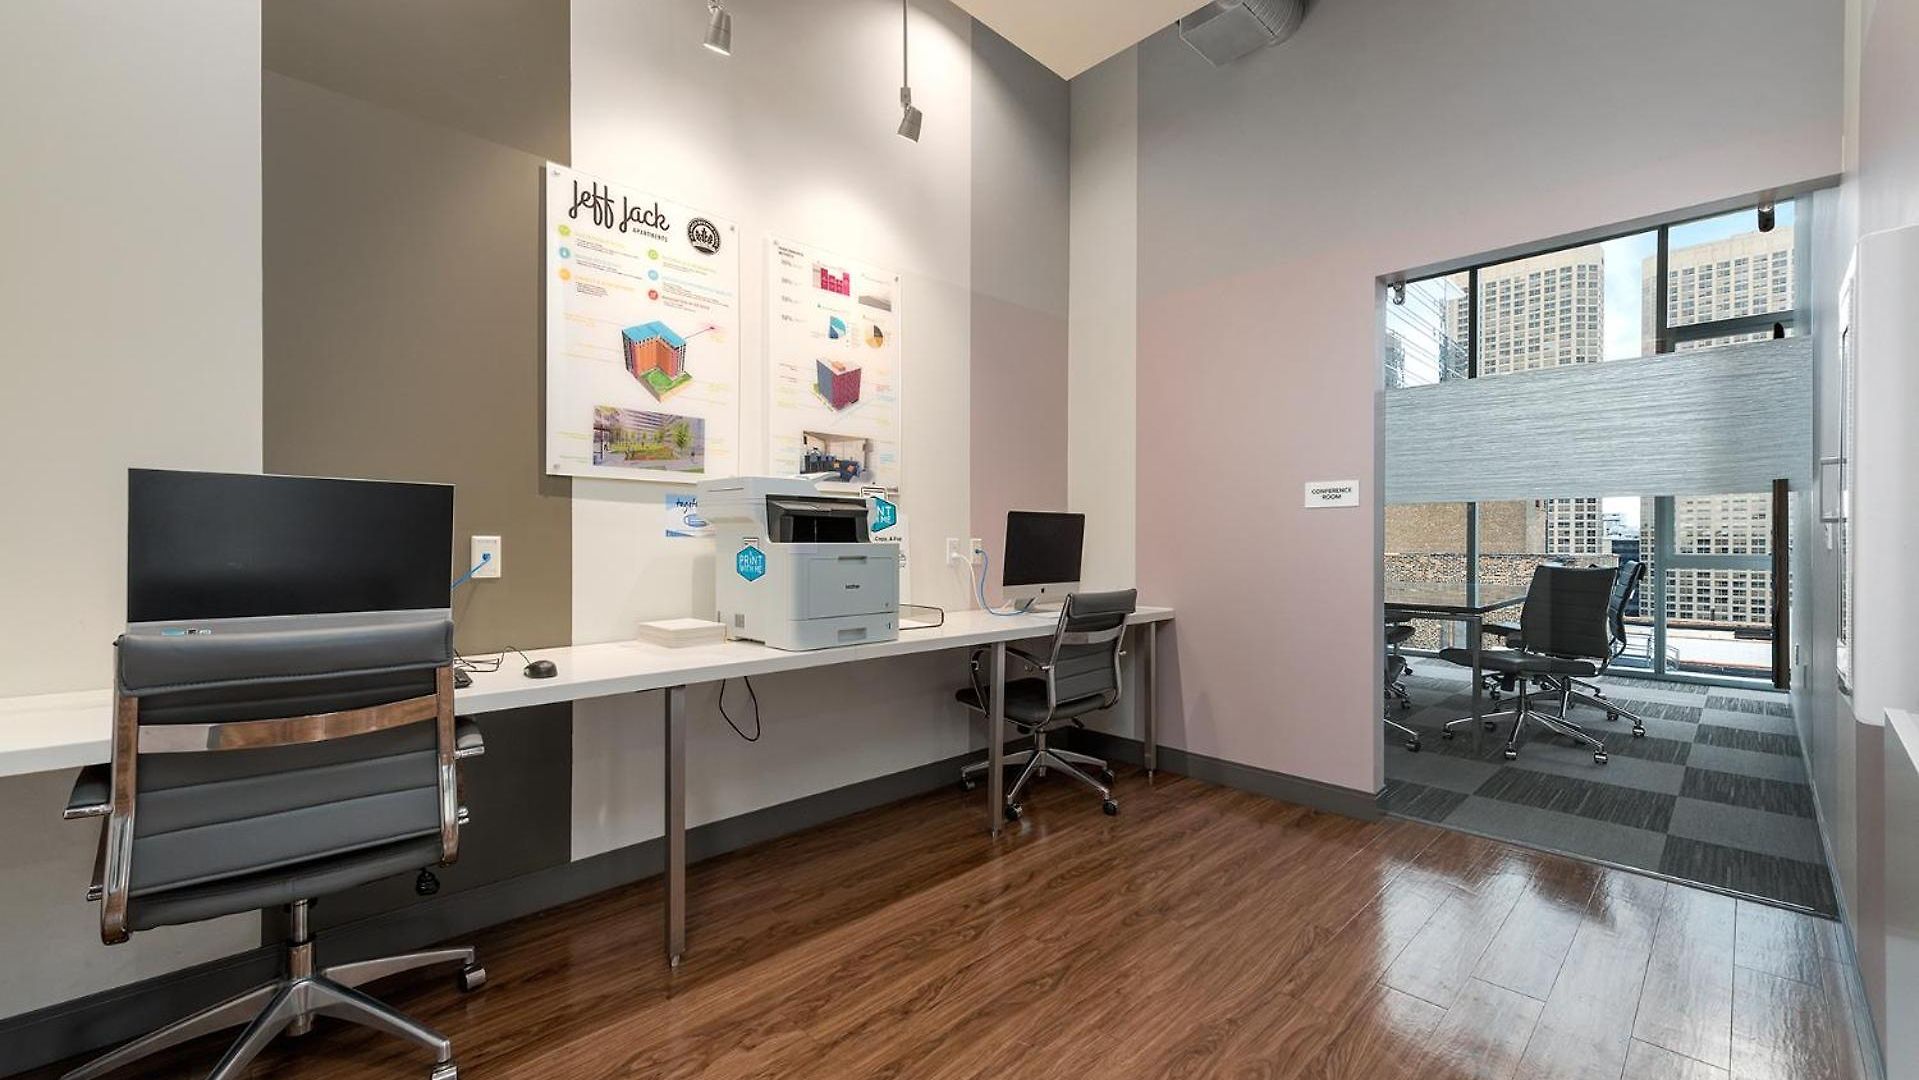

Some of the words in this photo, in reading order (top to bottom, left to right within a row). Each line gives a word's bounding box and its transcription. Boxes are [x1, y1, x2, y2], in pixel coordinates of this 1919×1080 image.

[632, 227, 668, 243] APARTMENTS
[1311, 486, 1352, 495] CONFERENCE
[739, 554, 763, 566] PRINT
